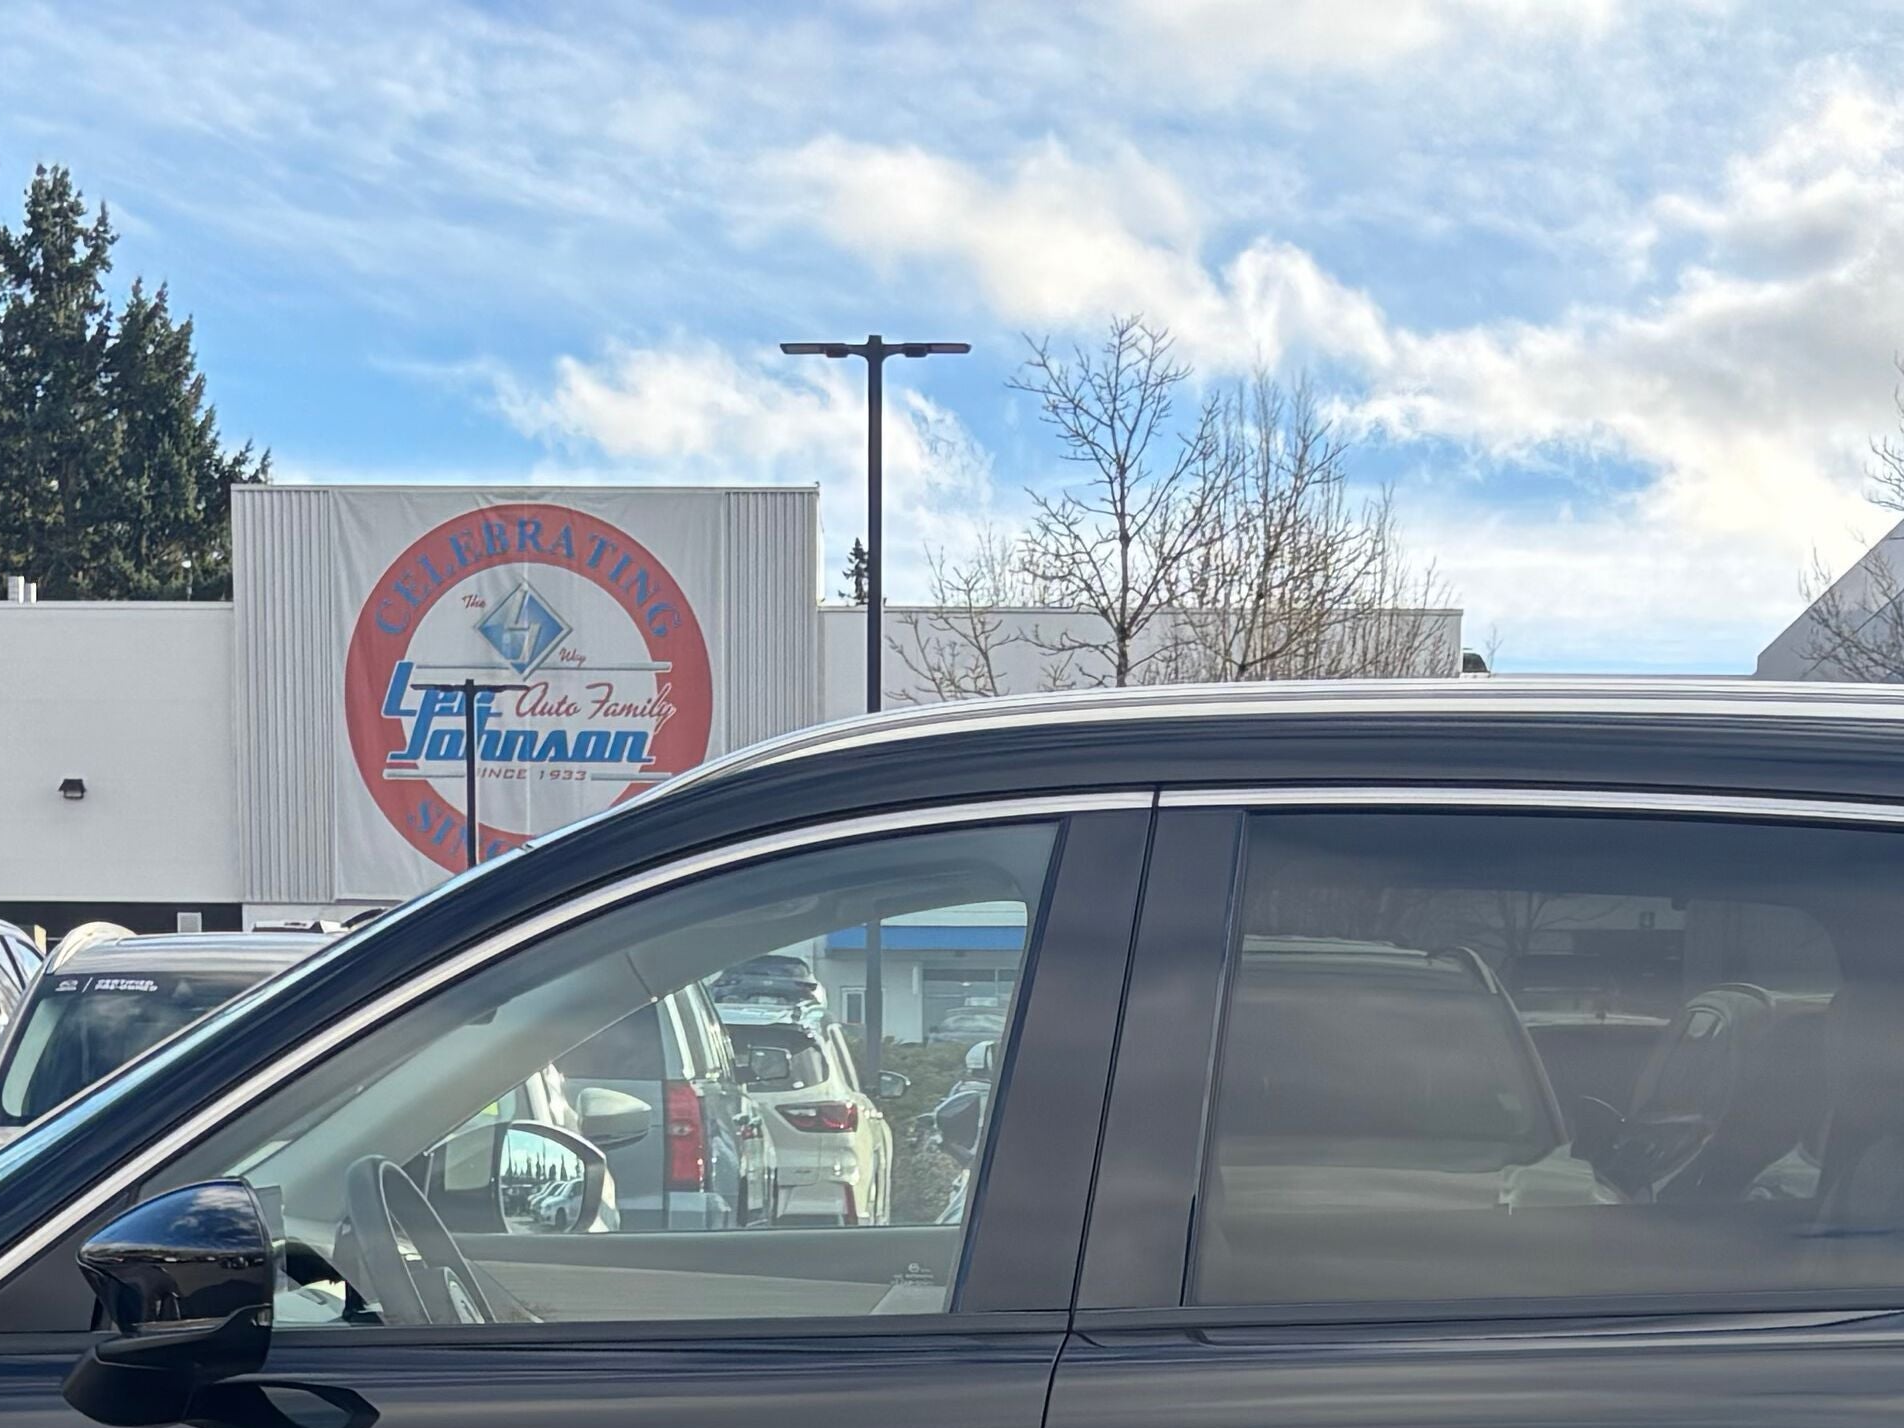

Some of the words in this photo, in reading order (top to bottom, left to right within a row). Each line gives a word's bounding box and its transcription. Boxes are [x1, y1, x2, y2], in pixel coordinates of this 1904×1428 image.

[374, 517, 682, 638] CELEBRATING
[388, 688, 655, 763] Johnson
[515, 682, 582, 719] Auto
[585, 682, 676, 734] Family
[476, 767, 528, 780] INCE
[539, 769, 588, 781] 1933
